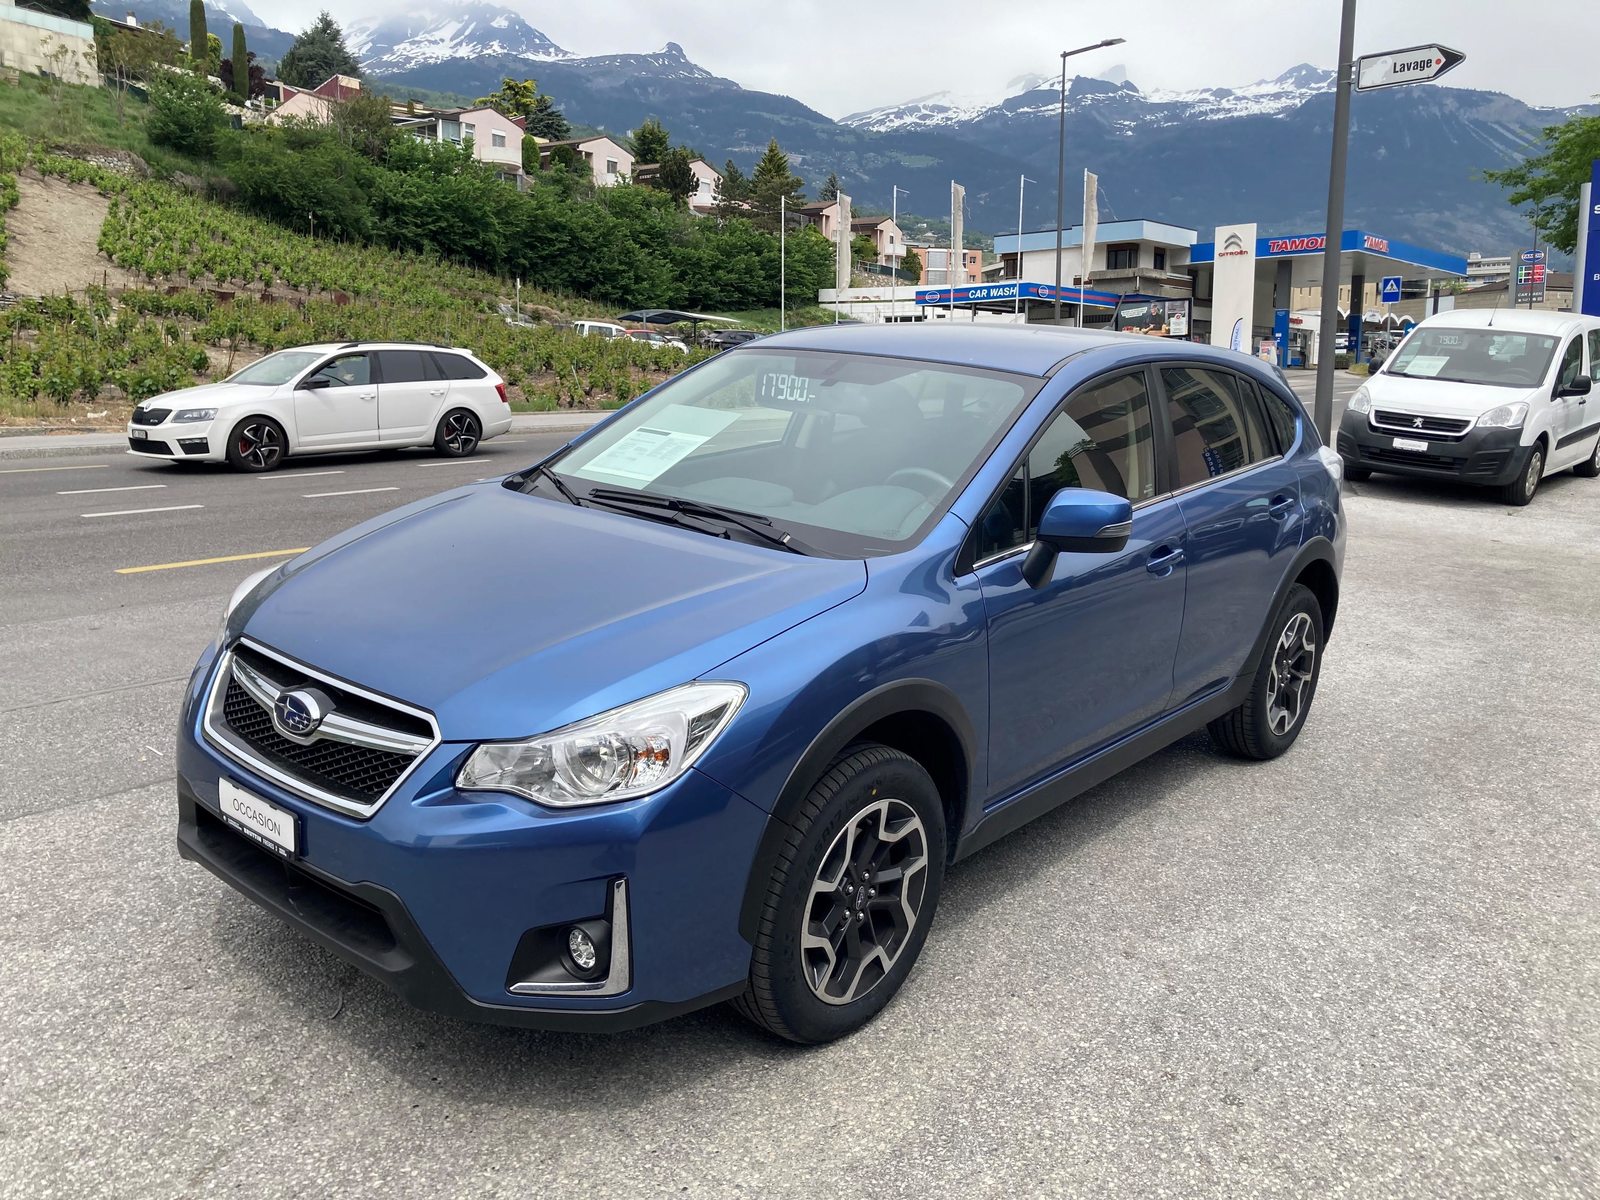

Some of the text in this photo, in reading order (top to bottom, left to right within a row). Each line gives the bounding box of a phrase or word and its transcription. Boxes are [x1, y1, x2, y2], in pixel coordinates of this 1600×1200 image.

[1393, 58, 1432, 73] Lavage
[1269, 236, 1326, 253] TAMOI
[969, 286, 1017, 299] CAR WASH
[232, 798, 281, 837] OCCASION
